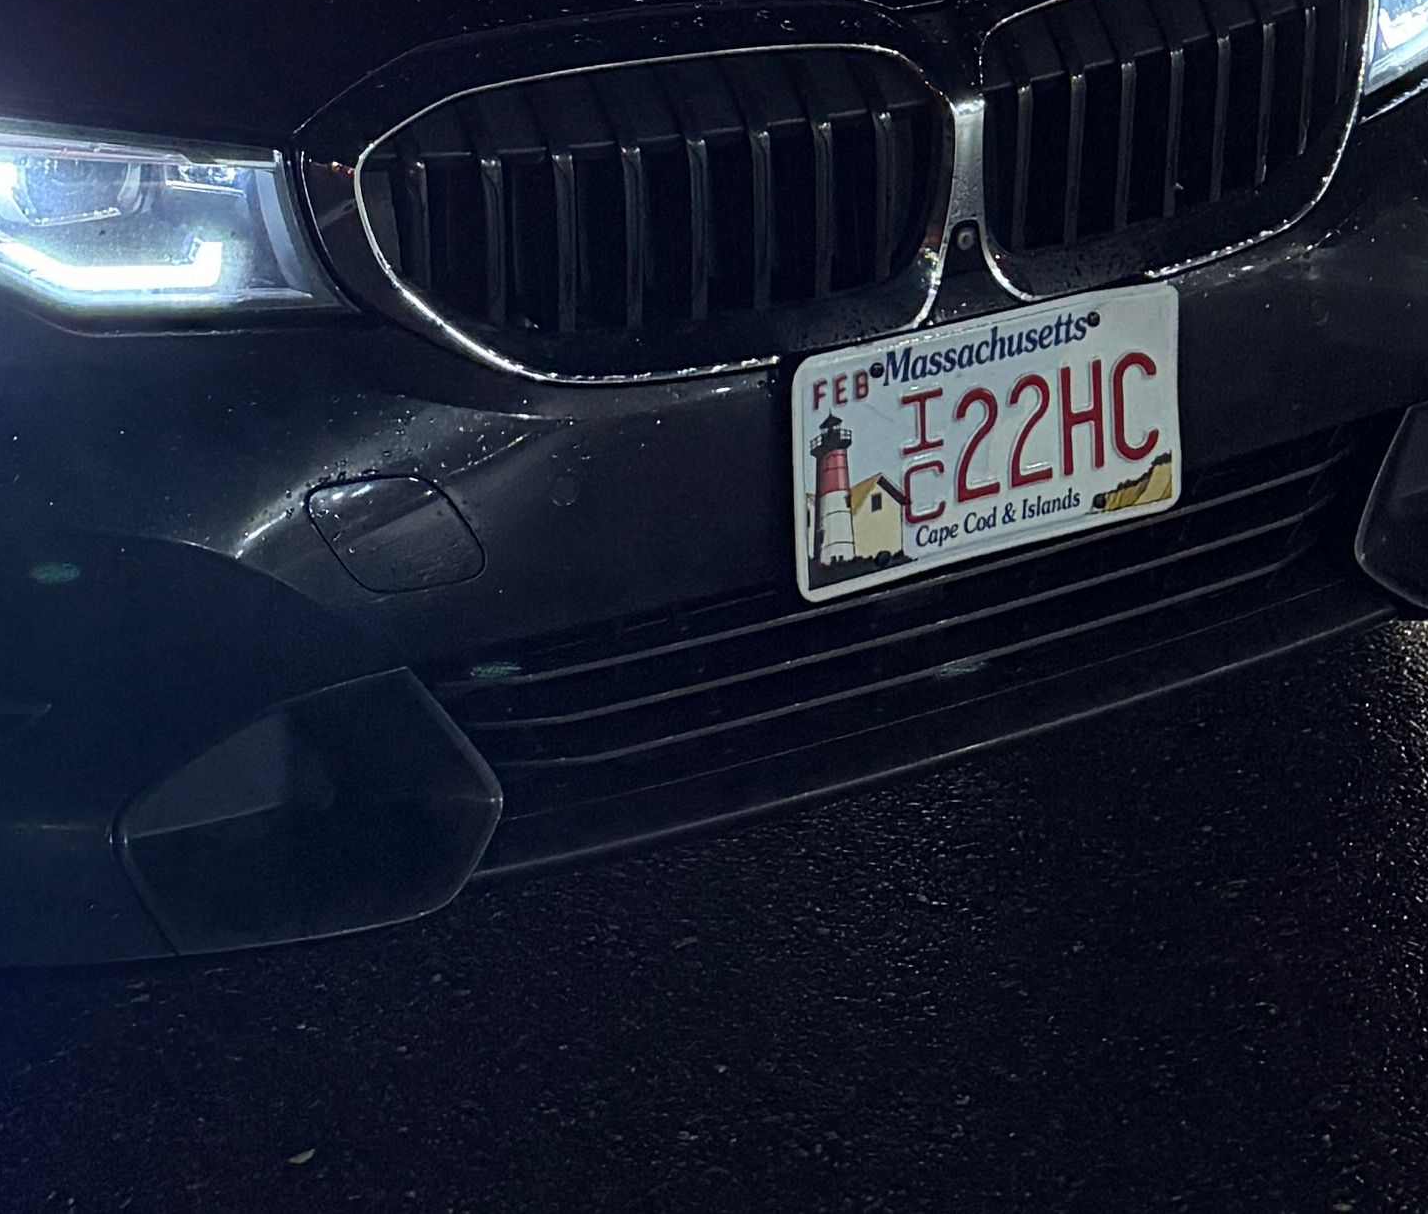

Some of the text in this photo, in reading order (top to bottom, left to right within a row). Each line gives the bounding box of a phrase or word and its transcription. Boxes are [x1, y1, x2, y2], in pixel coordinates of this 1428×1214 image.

[811, 312, 1088, 411] FEB Massachusetts
[954, 351, 1161, 504] 22HC
[915, 487, 1081, 548] Cape Cod & Islands
